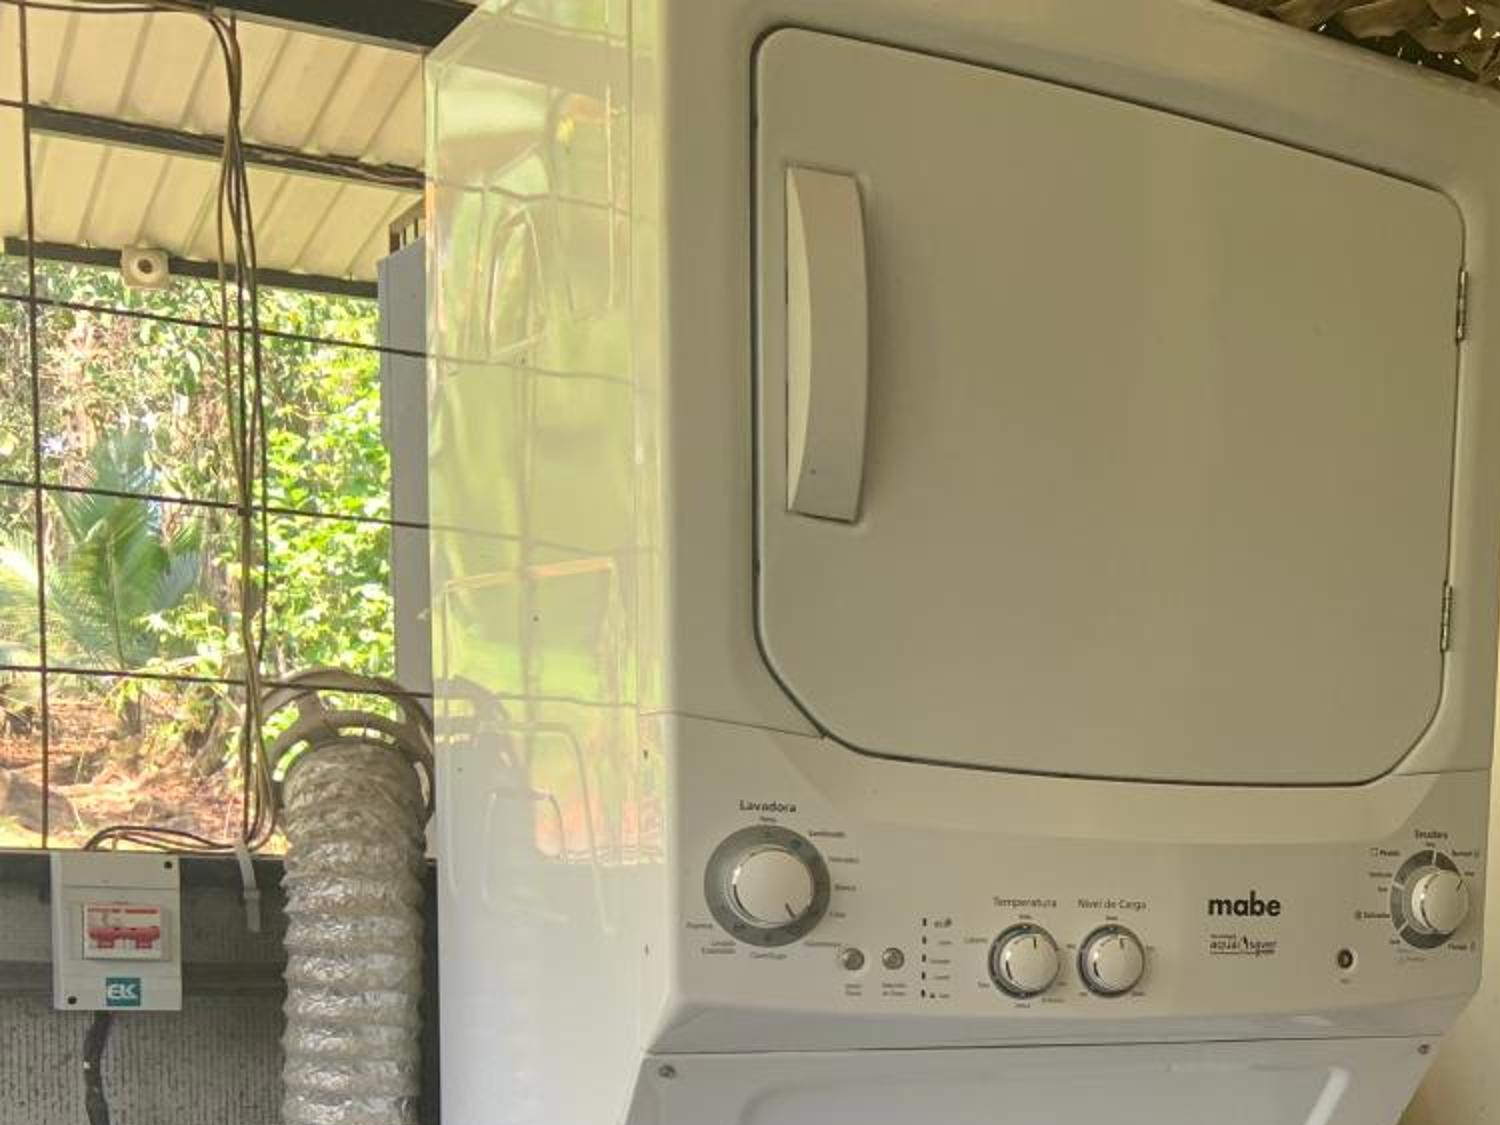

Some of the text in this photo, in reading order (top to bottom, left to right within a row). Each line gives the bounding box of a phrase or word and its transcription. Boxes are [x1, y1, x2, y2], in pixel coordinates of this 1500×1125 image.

[739, 799, 797, 813] Lavadora
[993, 896, 1057, 909] Temperatura
[1078, 898, 1101, 909] Nivel
[1208, 890, 1281, 917] mabe
